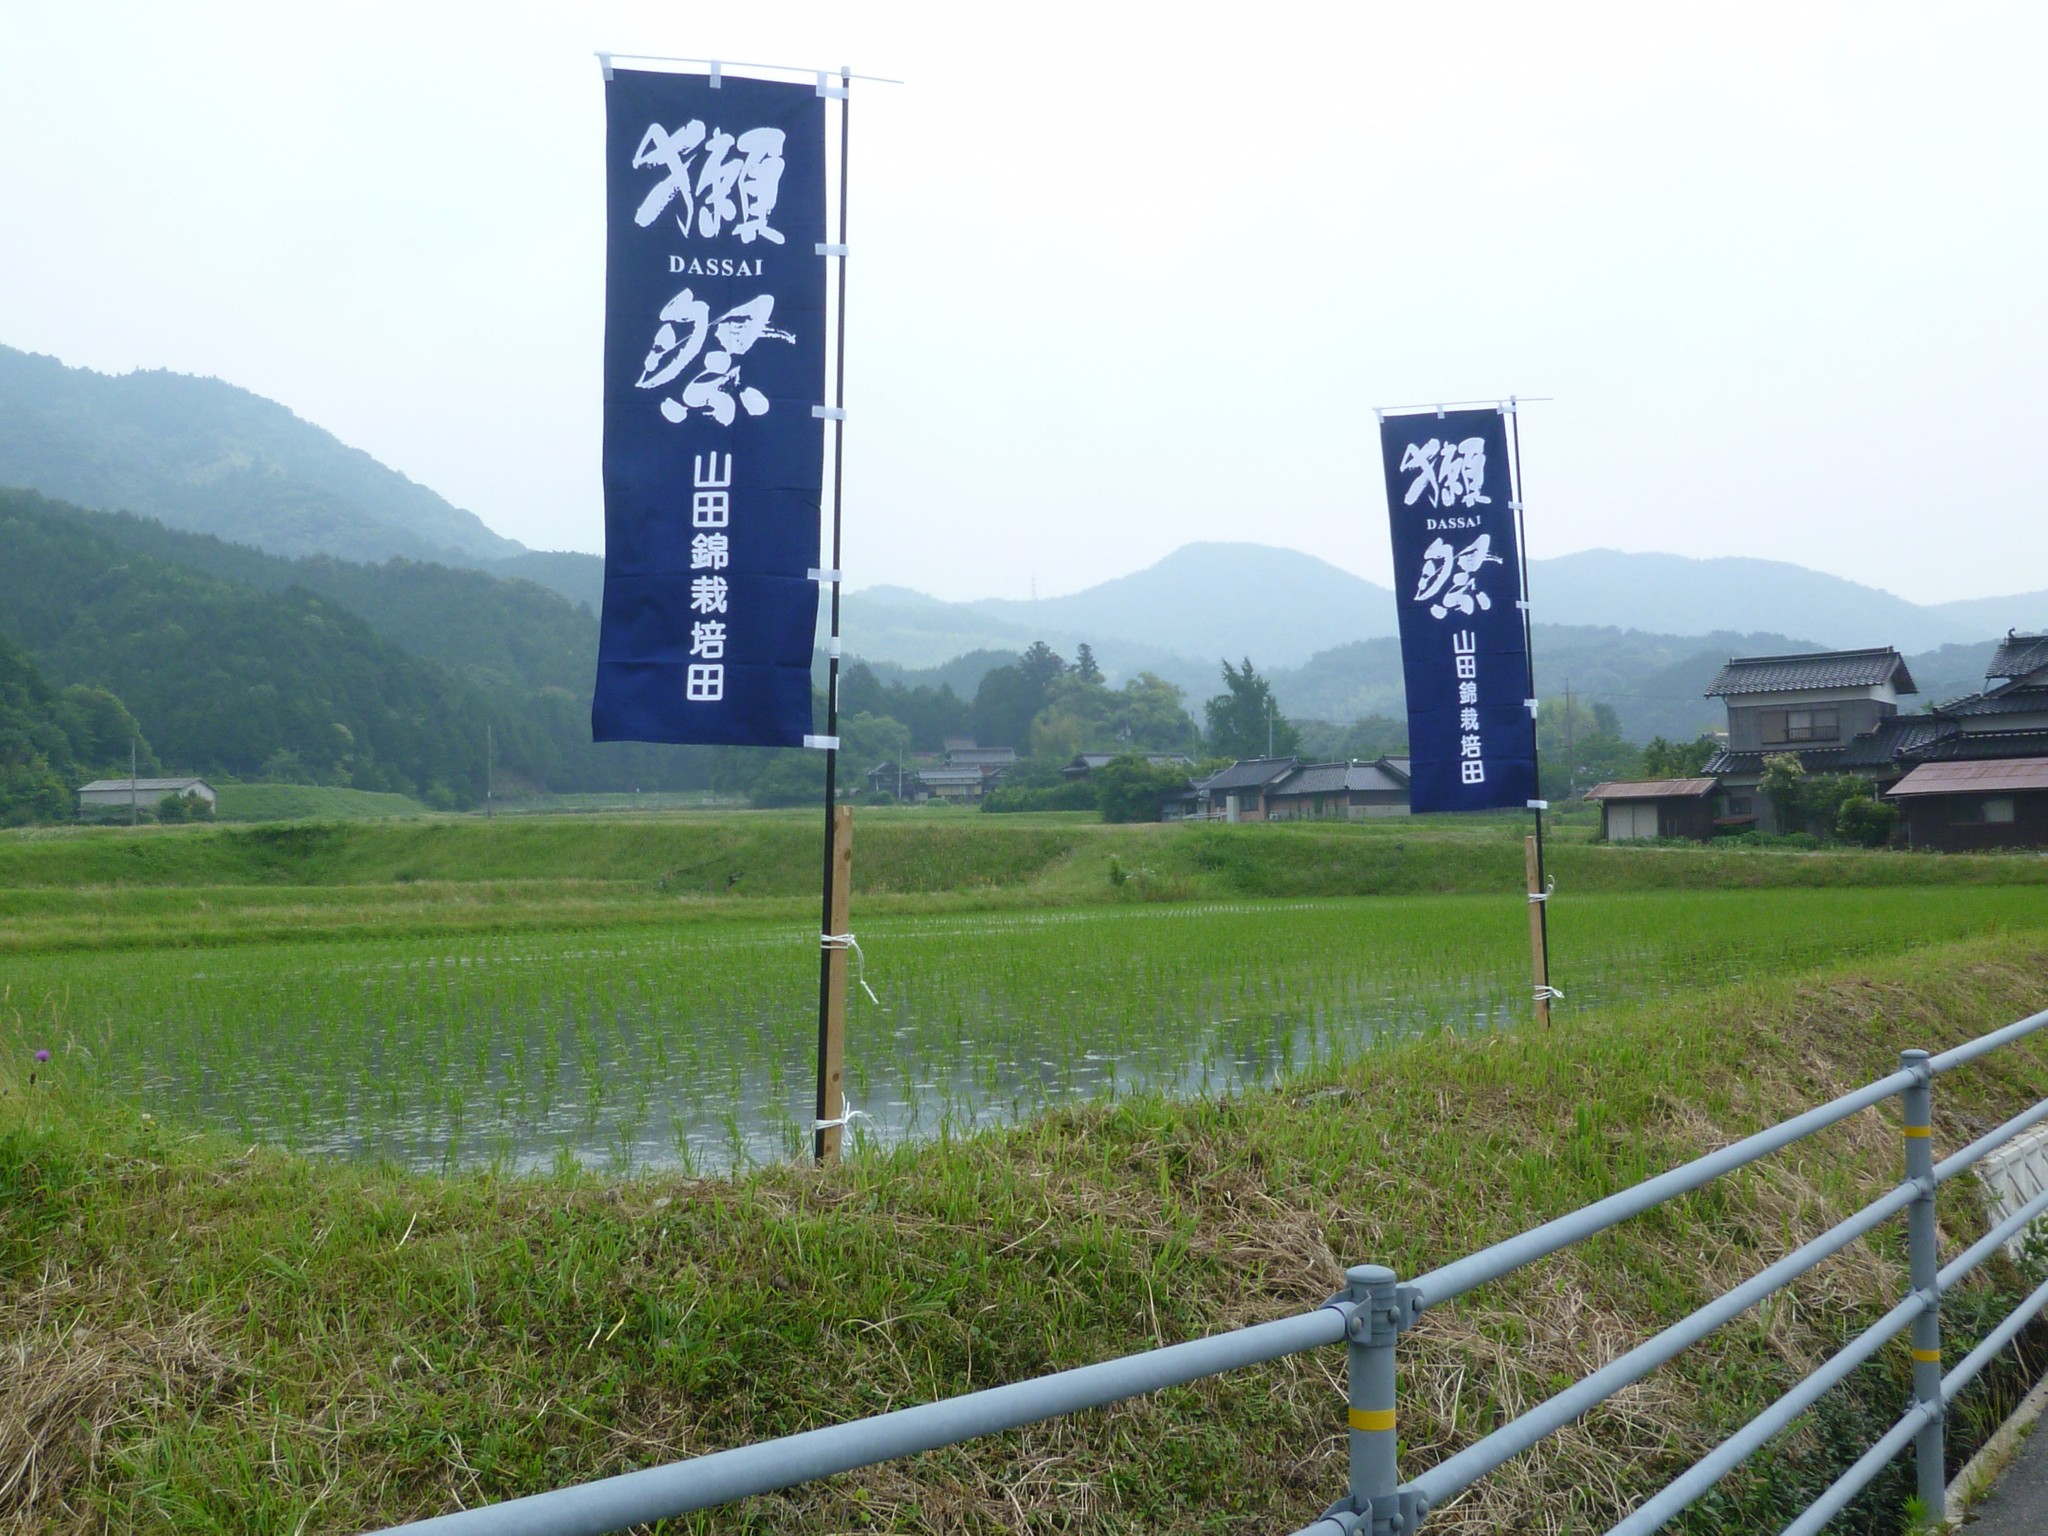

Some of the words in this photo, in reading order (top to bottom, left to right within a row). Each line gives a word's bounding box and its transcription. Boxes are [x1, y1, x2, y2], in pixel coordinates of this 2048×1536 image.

[669, 255, 764, 277] DASSAI
[635, 287, 796, 427] 祭
[686, 450, 732, 702] 山田錦栽培田
[1413, 533, 1503, 620] 祭
[1426, 515, 1482, 531] DASSAI
[1453, 629, 1485, 784] 山田錦栽培田
